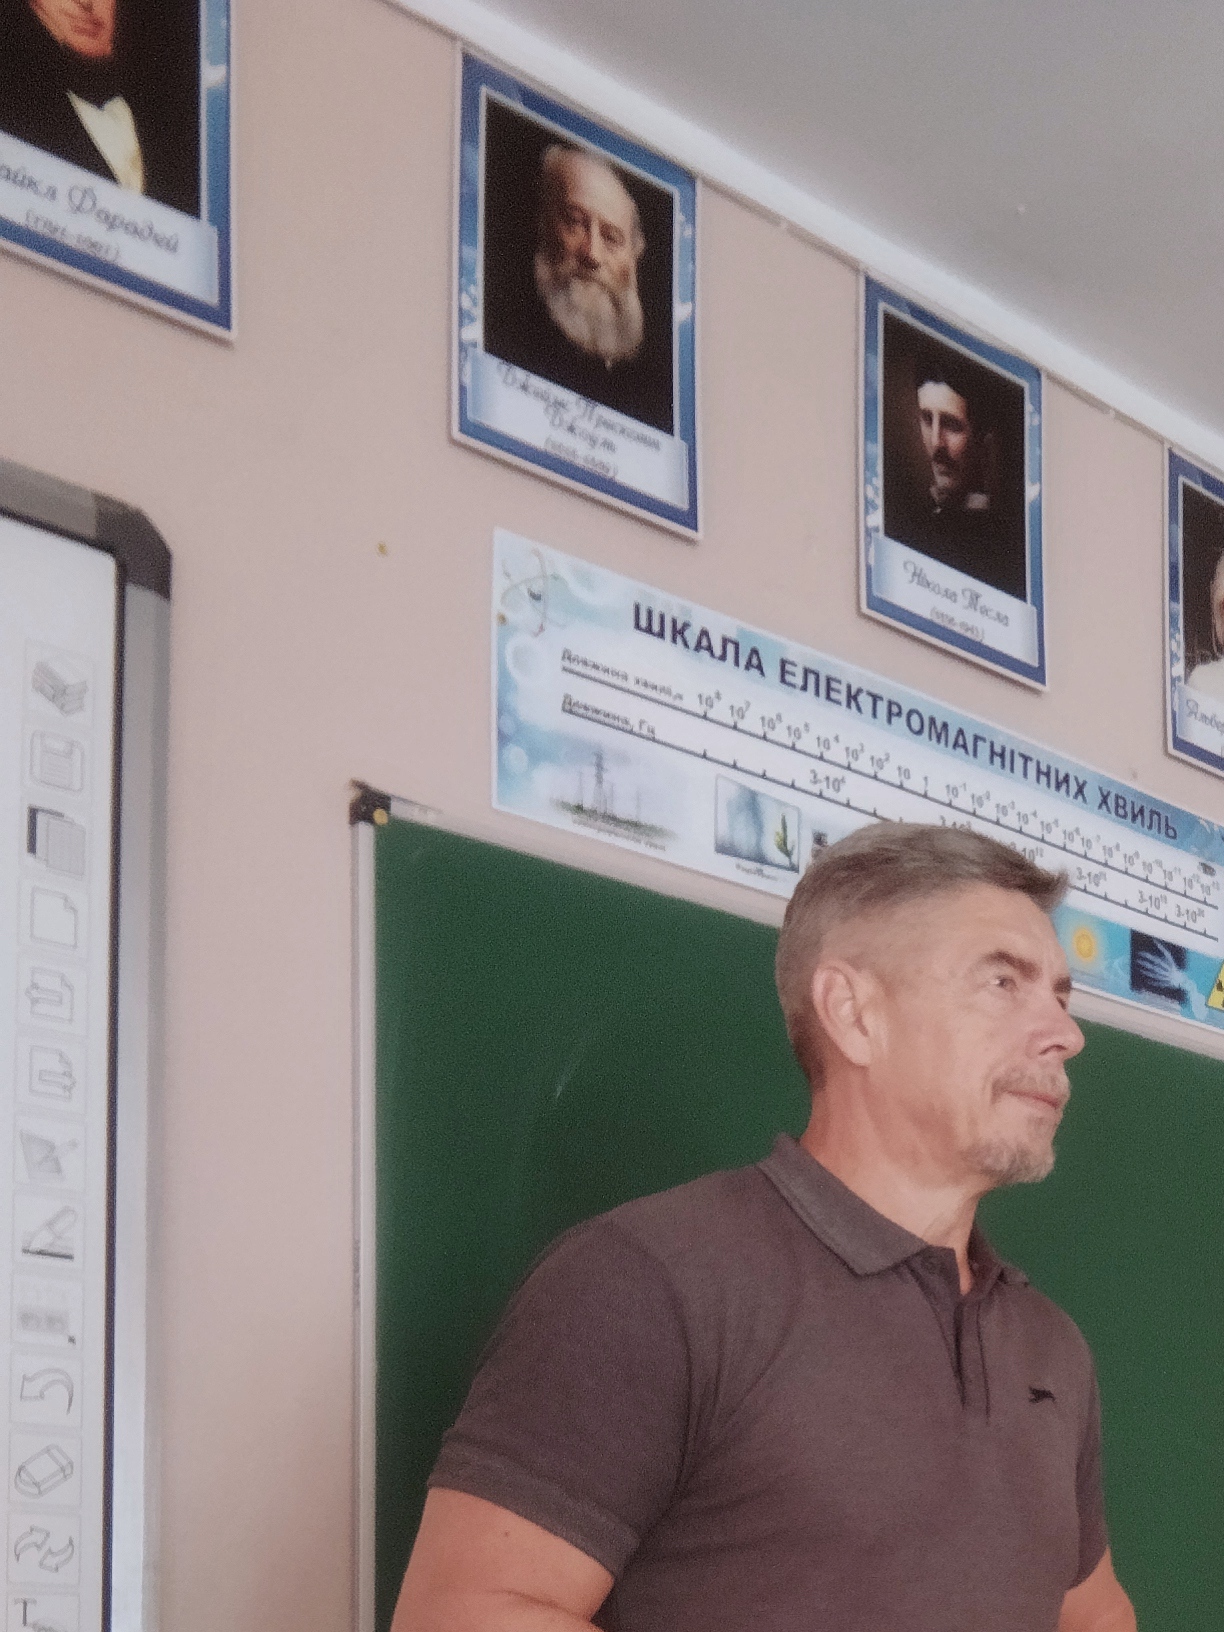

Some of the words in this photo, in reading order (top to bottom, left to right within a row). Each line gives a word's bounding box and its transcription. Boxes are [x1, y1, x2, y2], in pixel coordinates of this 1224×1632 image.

[961, 587, 1010, 628] Тесла
[633, 601, 766, 678] ШКАЛА
[779, 656, 1088, 806] ЕЛЕКТРОМАГНІТНИХ
[1097, 785, 1178, 841] ХВИЛЬ
[897, 765, 911, 780] 10
